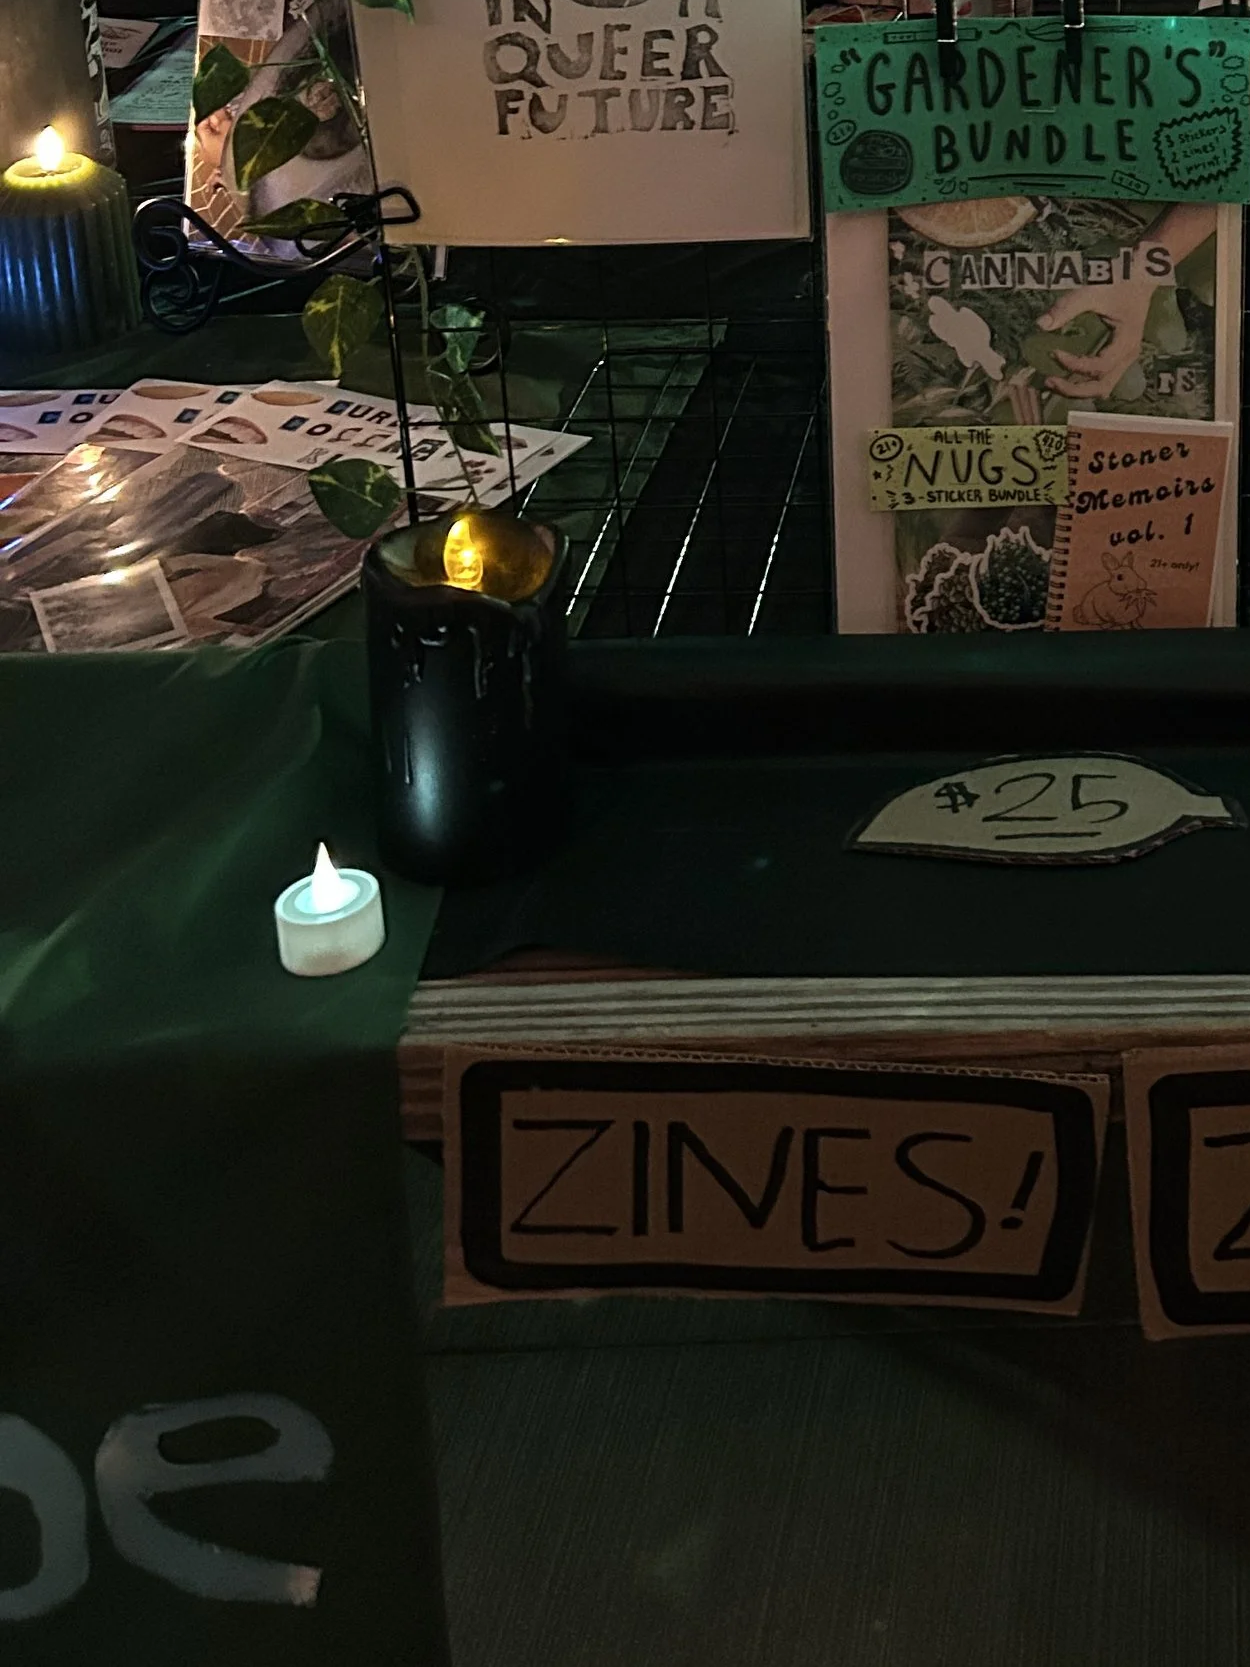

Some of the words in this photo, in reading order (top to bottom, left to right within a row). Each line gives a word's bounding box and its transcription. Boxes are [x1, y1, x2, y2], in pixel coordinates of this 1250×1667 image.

[483, 24, 731, 88] QUEER
[495, 85, 735, 136] FUTURE
[934, 119, 1138, 175] BUNDLE
[924, 246, 1172, 285] CANNABIS
[876, 438, 898, 455] 21+
[933, 430, 962, 445] ALL
[967, 428, 993, 445] THE
[903, 445, 1040, 488] NUGS
[1087, 441, 1191, 475] Stoner
[988, 487, 1042, 503] BUNDLE
[1074, 476, 1216, 515] Memoirs
[1109, 519, 1165, 547] vol.
[1184, 512, 1194, 536] 1
[933, 772, 1129, 824] $25
[509, 1118, 1045, 1260] ZINES!
